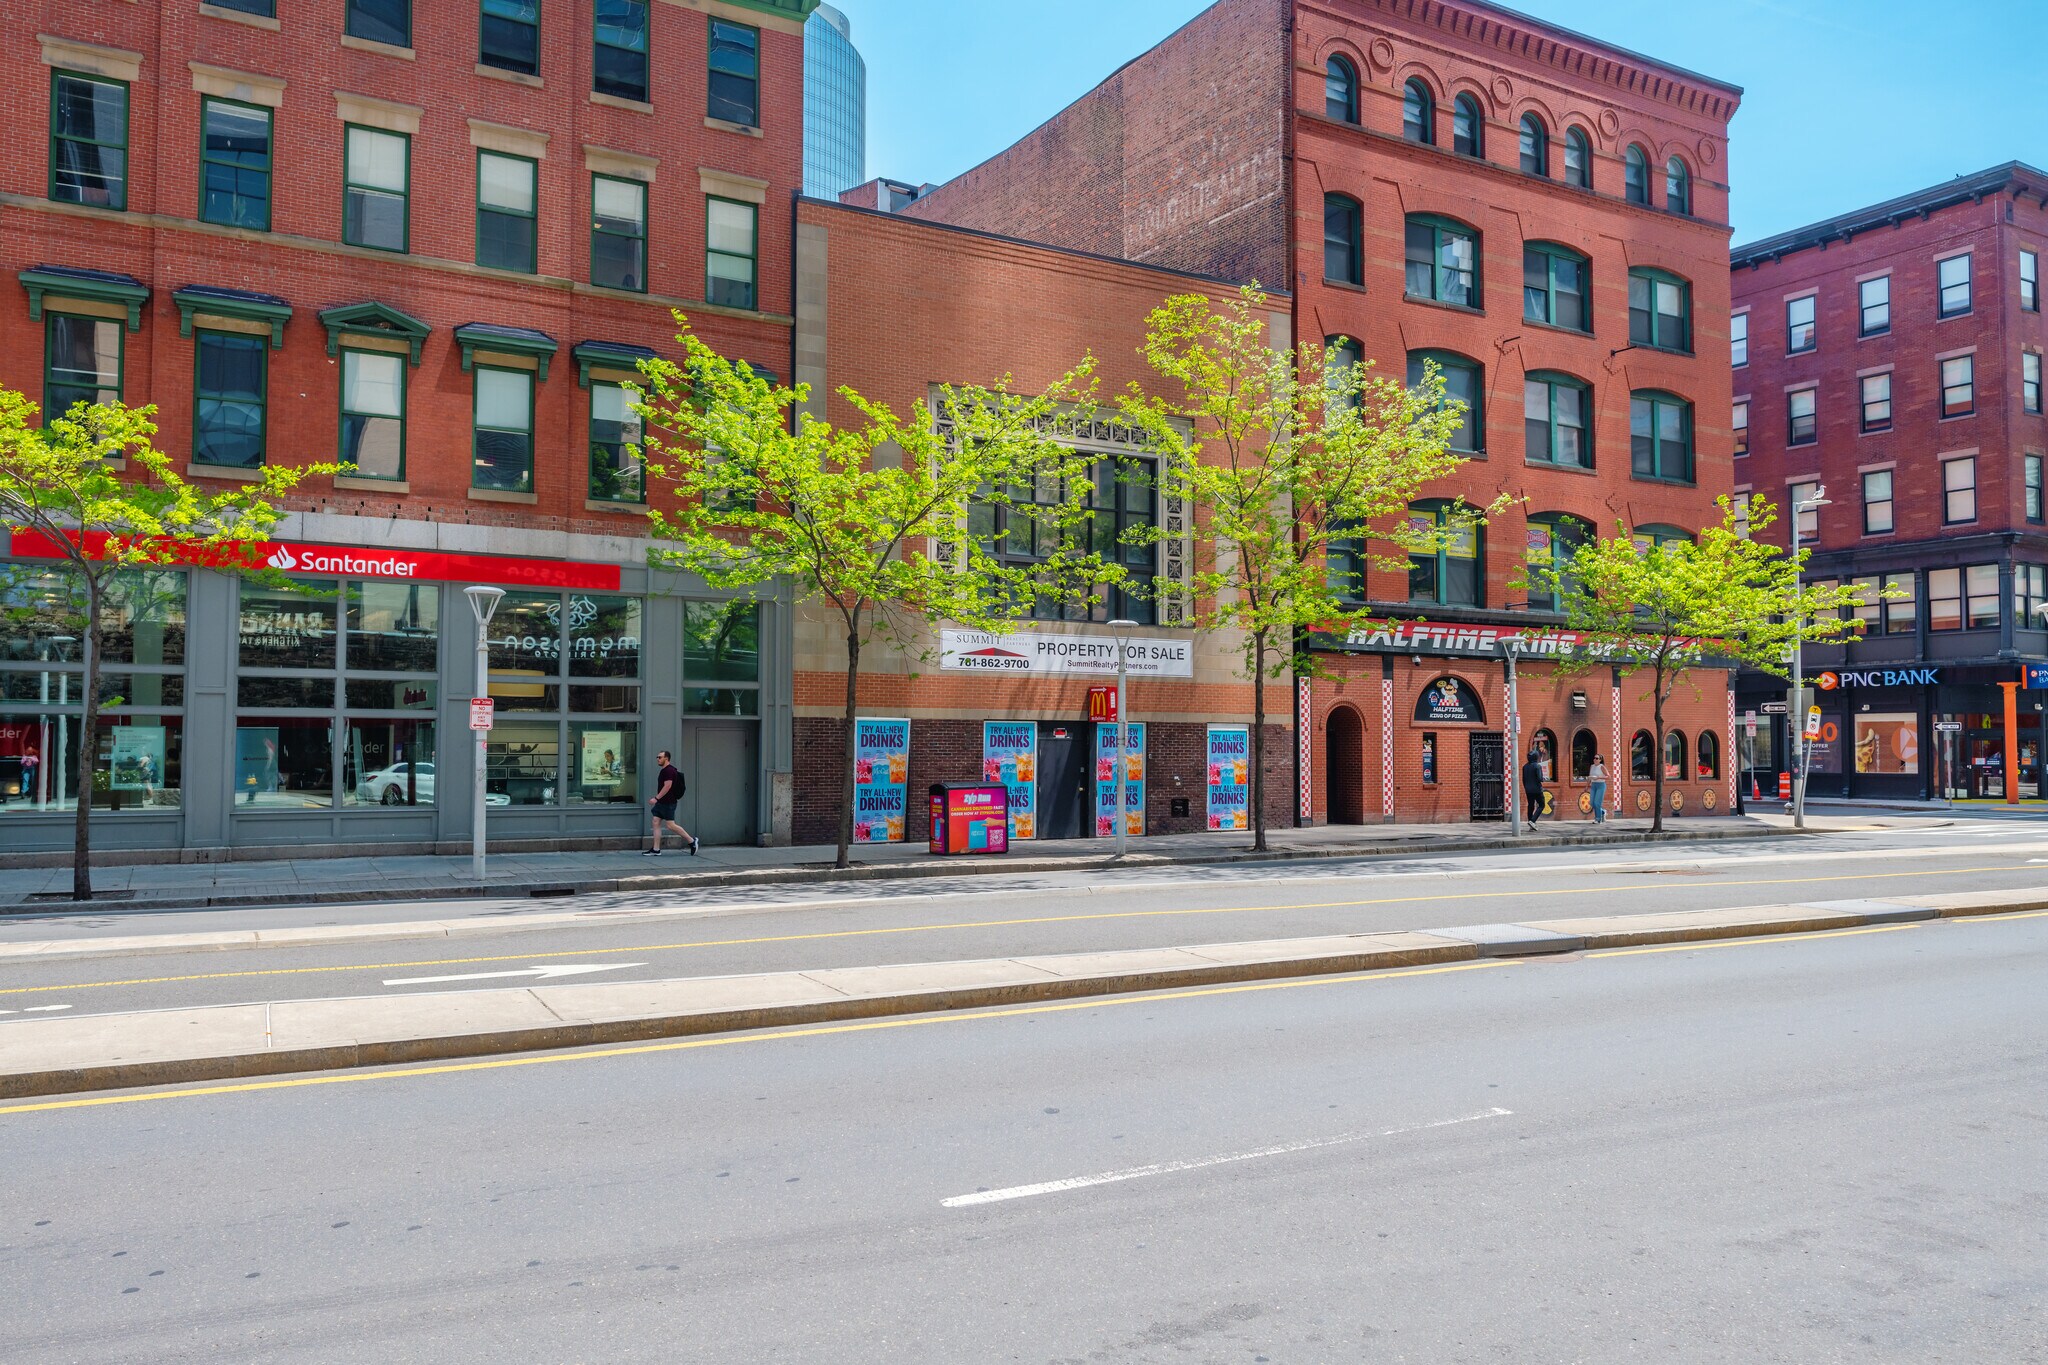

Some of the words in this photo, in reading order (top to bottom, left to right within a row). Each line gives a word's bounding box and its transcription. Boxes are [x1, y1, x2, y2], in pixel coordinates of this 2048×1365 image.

[300, 551, 417, 576] Santander
[956, 634, 1001, 645] SUMMIT
[1347, 625, 1498, 651] HALFTIME
[1037, 642, 1114, 658] PROPERTY
[1126, 646, 1146, 659] OR
[1151, 646, 1185, 661] SALE
[958, 657, 1030, 669] 781-862-9700
[1067, 659, 1158, 671] SummitRealtyPtners.com
[1839, 671, 1881, 688] PNC
[1882, 668, 1938, 686] BANK
[861, 725, 874, 734] TRY
[875, 725, 904, 734] ALL-NEW
[990, 726, 1003, 735] TRY
[1003, 726, 1030, 735] ALL-NEW
[1102, 727, 1113, 736] TRY
[861, 733, 904, 748] DRINKS
[990, 734, 1030, 748] DRINKS
[1102, 735, 1139, 748] DRIKS
[1221, 734, 1244, 742] ALL-NEW
[1211, 741, 1245, 754] DRINKS
[860, 788, 872, 797] TRY
[873, 788, 902, 797] ALL-NEW
[1102, 785, 1112, 793] TRY
[859, 797, 901, 811] DRINKS
[1211, 792, 1245, 805] DRINKS
